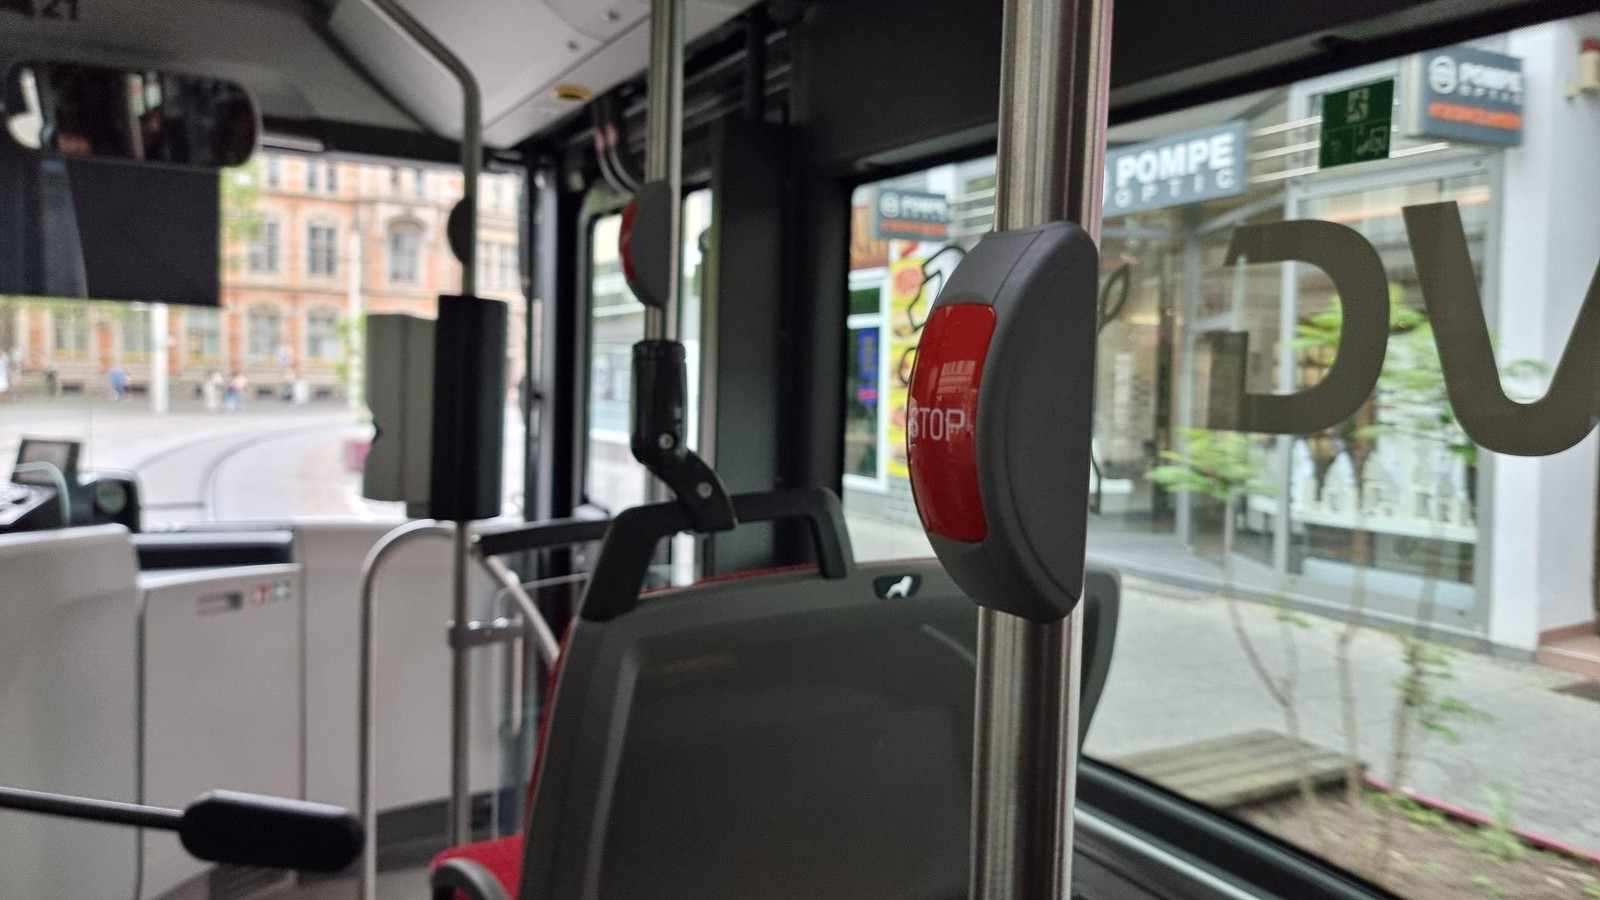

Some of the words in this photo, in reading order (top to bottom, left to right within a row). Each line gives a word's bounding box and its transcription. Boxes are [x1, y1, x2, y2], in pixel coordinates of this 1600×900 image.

[1116, 132, 1235, 189] POMPE
[1115, 167, 1235, 208] OPTIC
[909, 406, 966, 442] STOP
